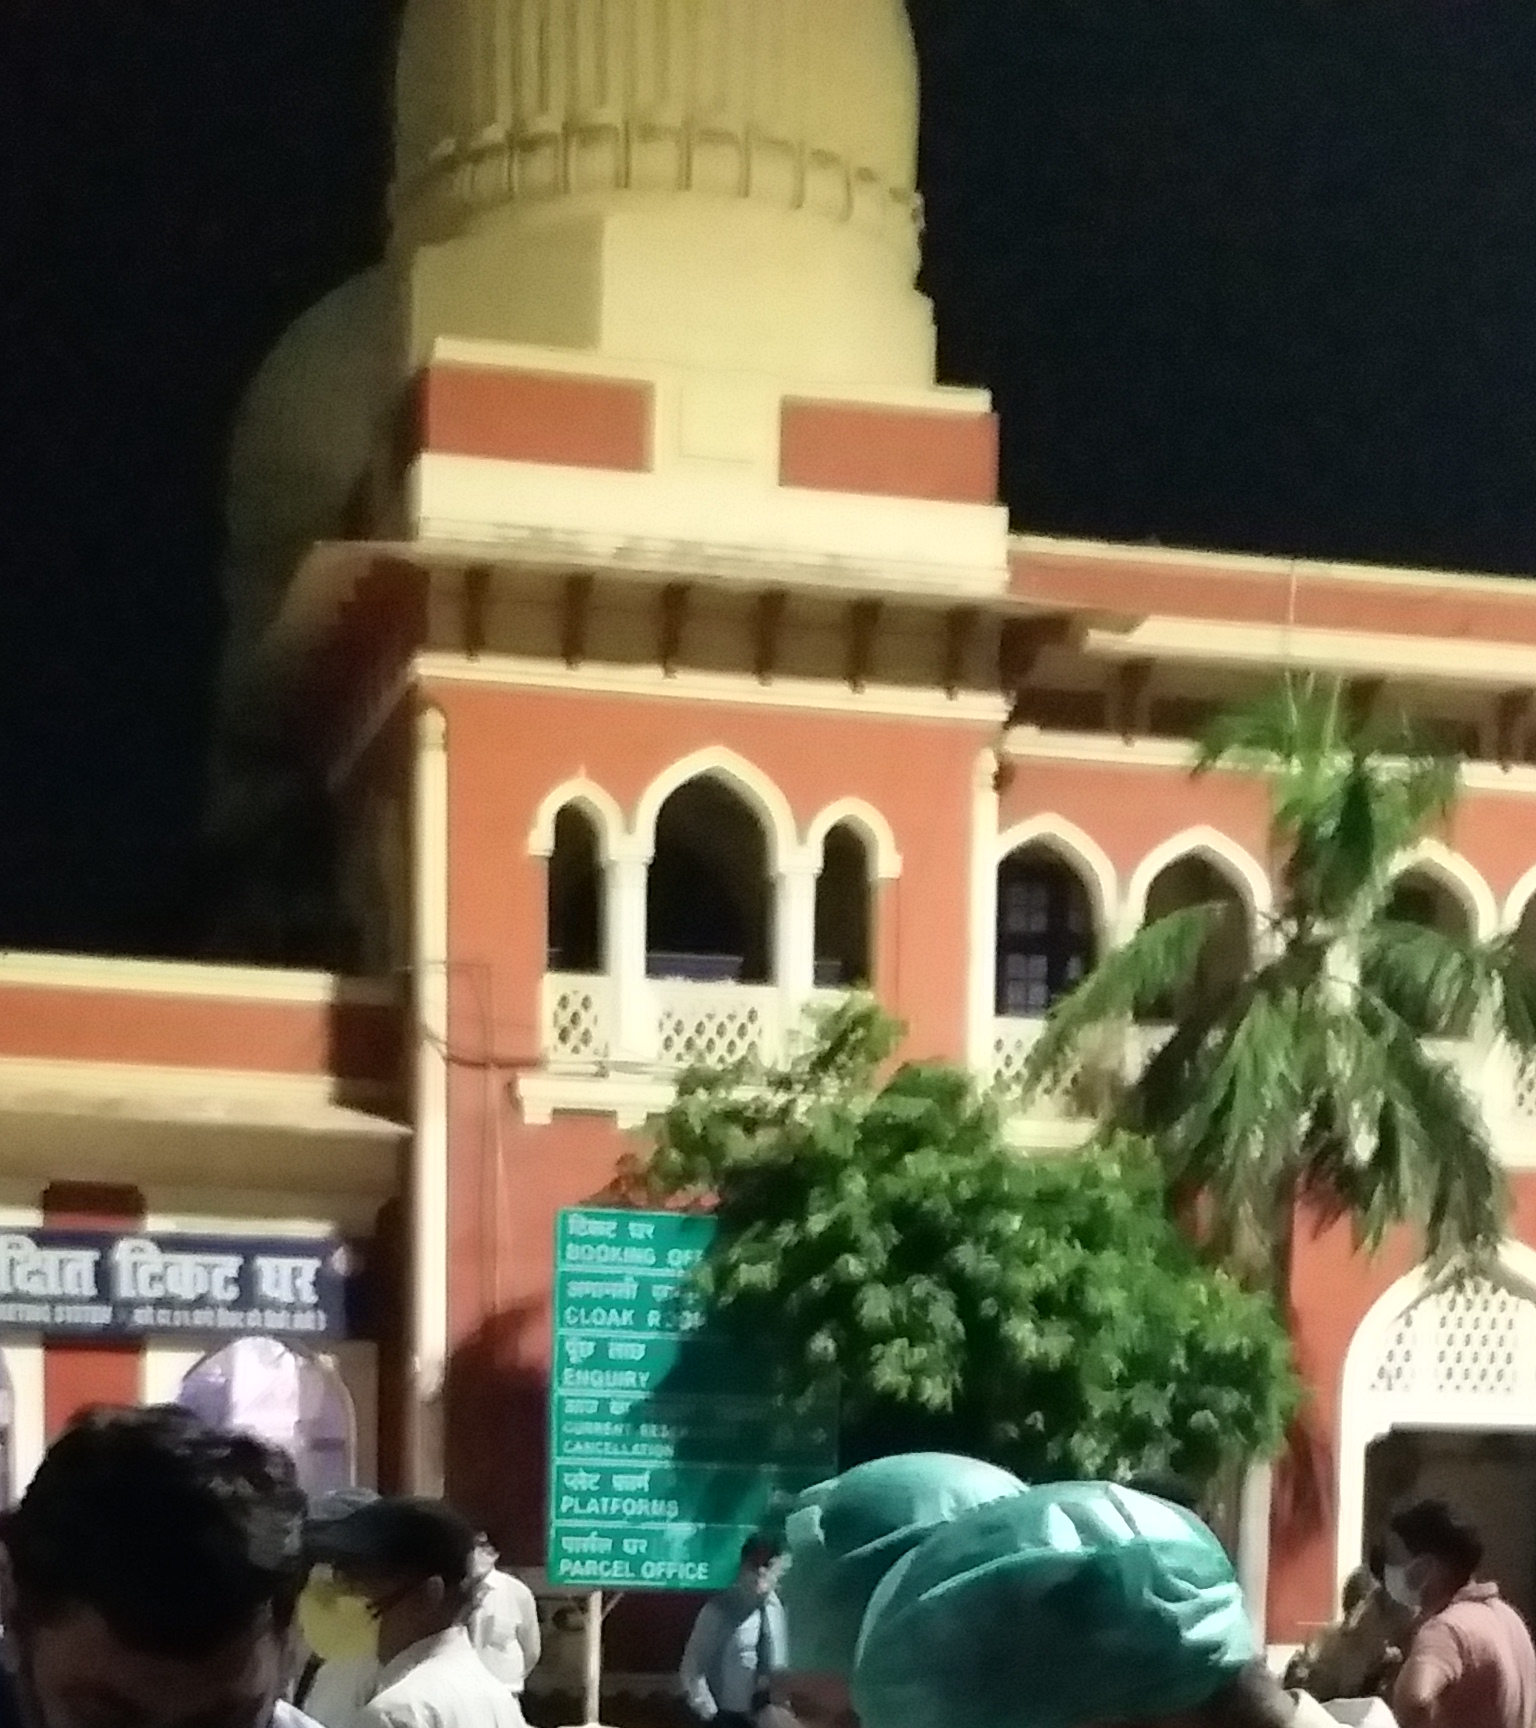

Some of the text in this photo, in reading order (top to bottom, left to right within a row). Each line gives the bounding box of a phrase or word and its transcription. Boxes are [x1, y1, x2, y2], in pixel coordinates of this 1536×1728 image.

[568, 1213, 655, 1239] टिकट घर
[566, 1243, 657, 1265] BOOKING
[116, 1238, 244, 1301] टिकट
[255, 1256, 322, 1304] घर
[565, 1305, 635, 1326] CLOAK
[562, 1367, 650, 1388] ENQUIRY
[562, 1440, 674, 1457] CANCELLATION
[560, 1496, 678, 1518] PLATFORMS
[558, 1558, 709, 1580] PARCEL OFFICE
